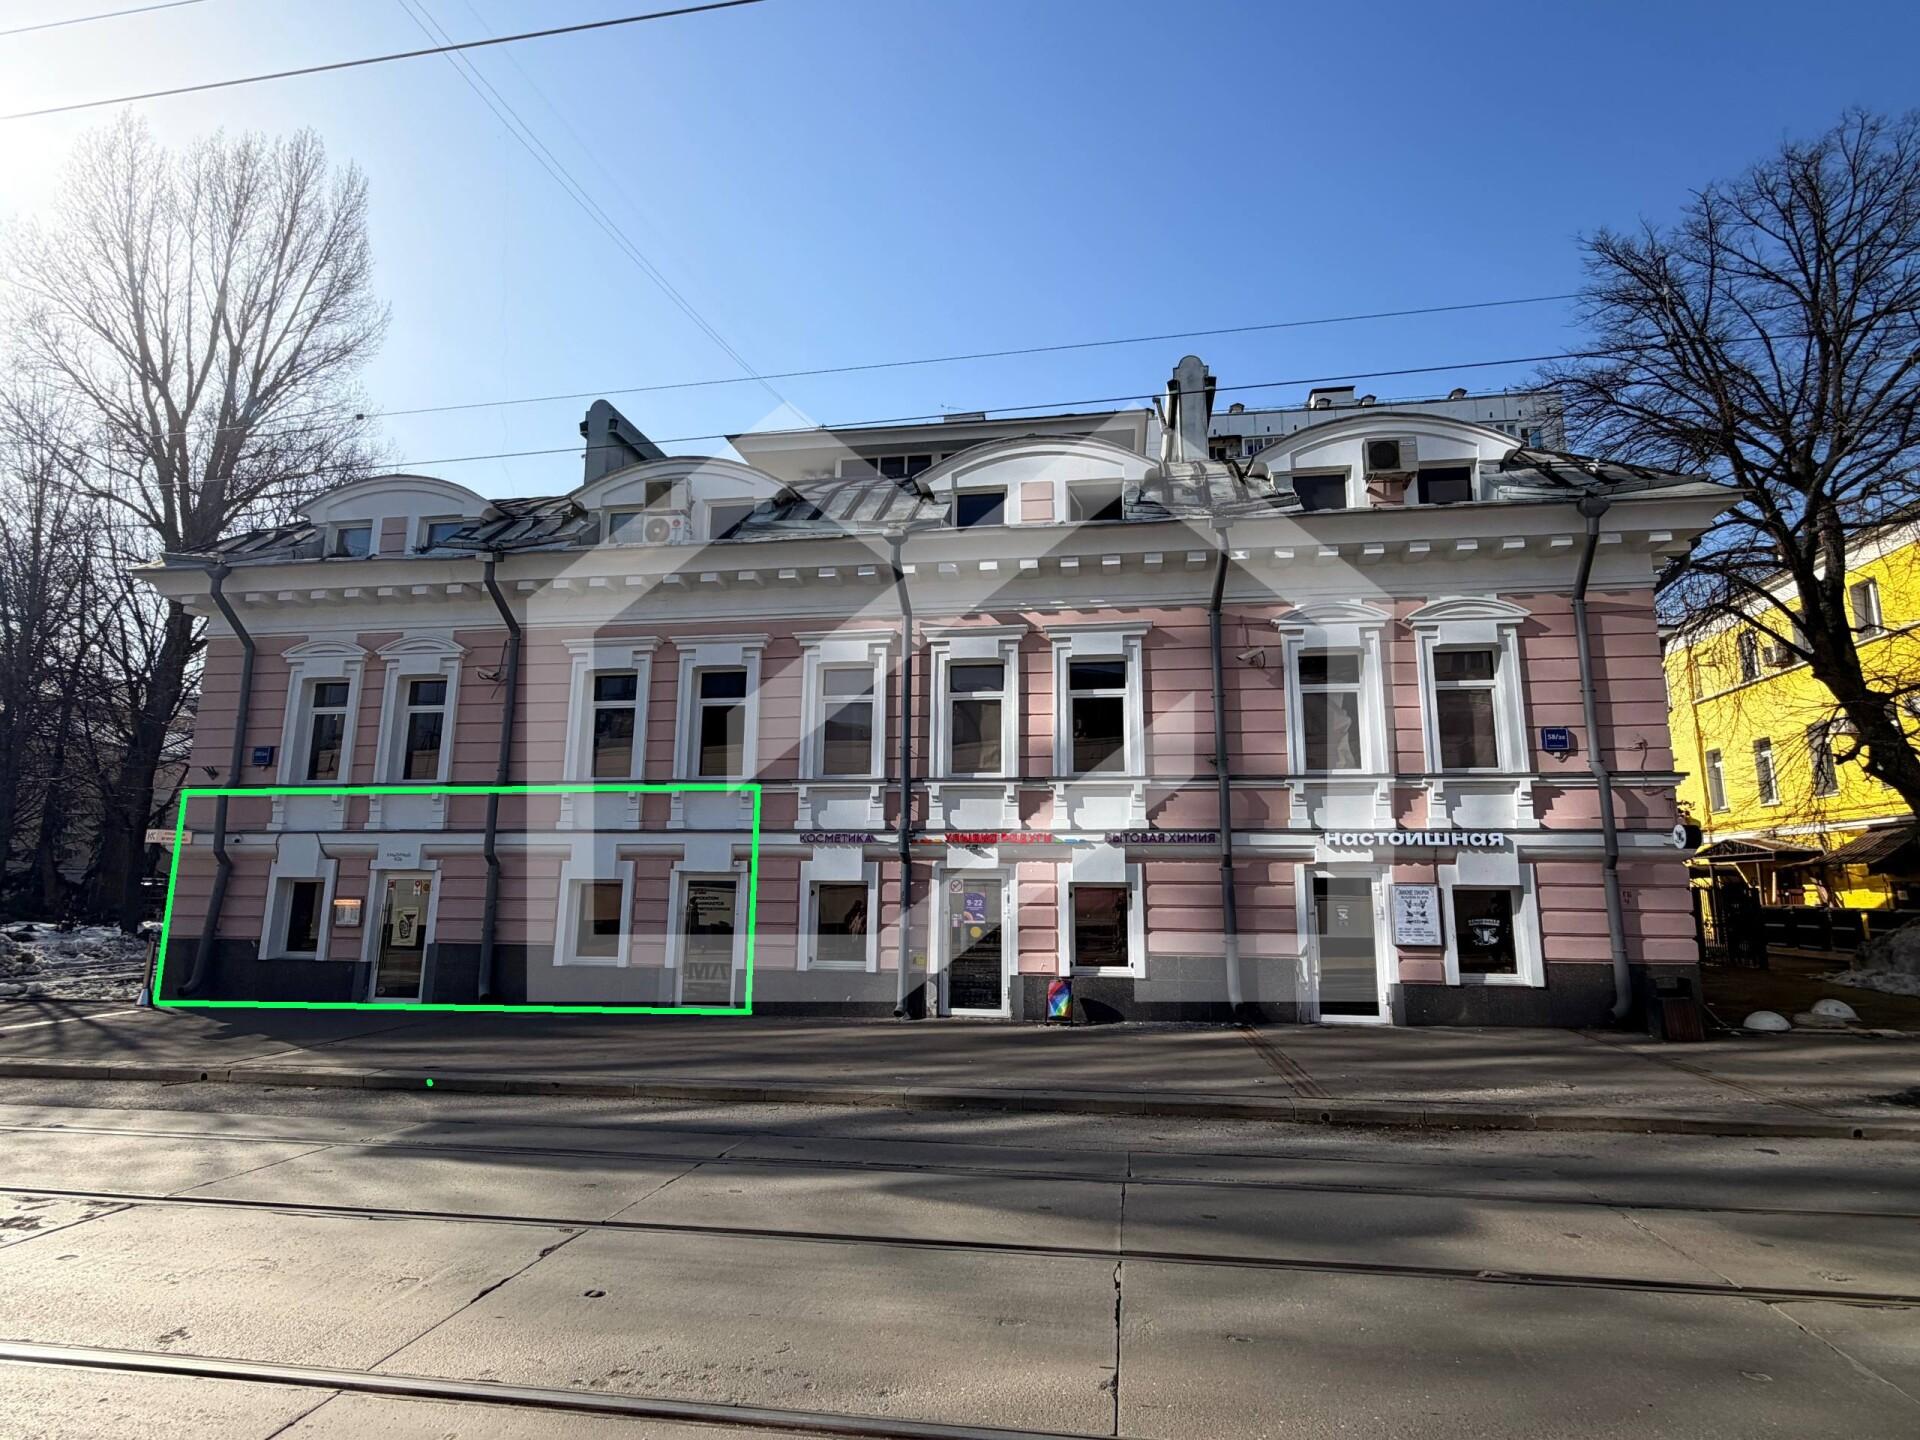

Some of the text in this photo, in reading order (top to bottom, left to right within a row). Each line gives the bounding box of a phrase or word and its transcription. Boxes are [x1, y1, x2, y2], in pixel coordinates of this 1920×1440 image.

[800, 833, 873, 844] КОСМЕТИКА
[1104, 832, 1216, 844] БЫТОВАЯ ХИМИЯ
